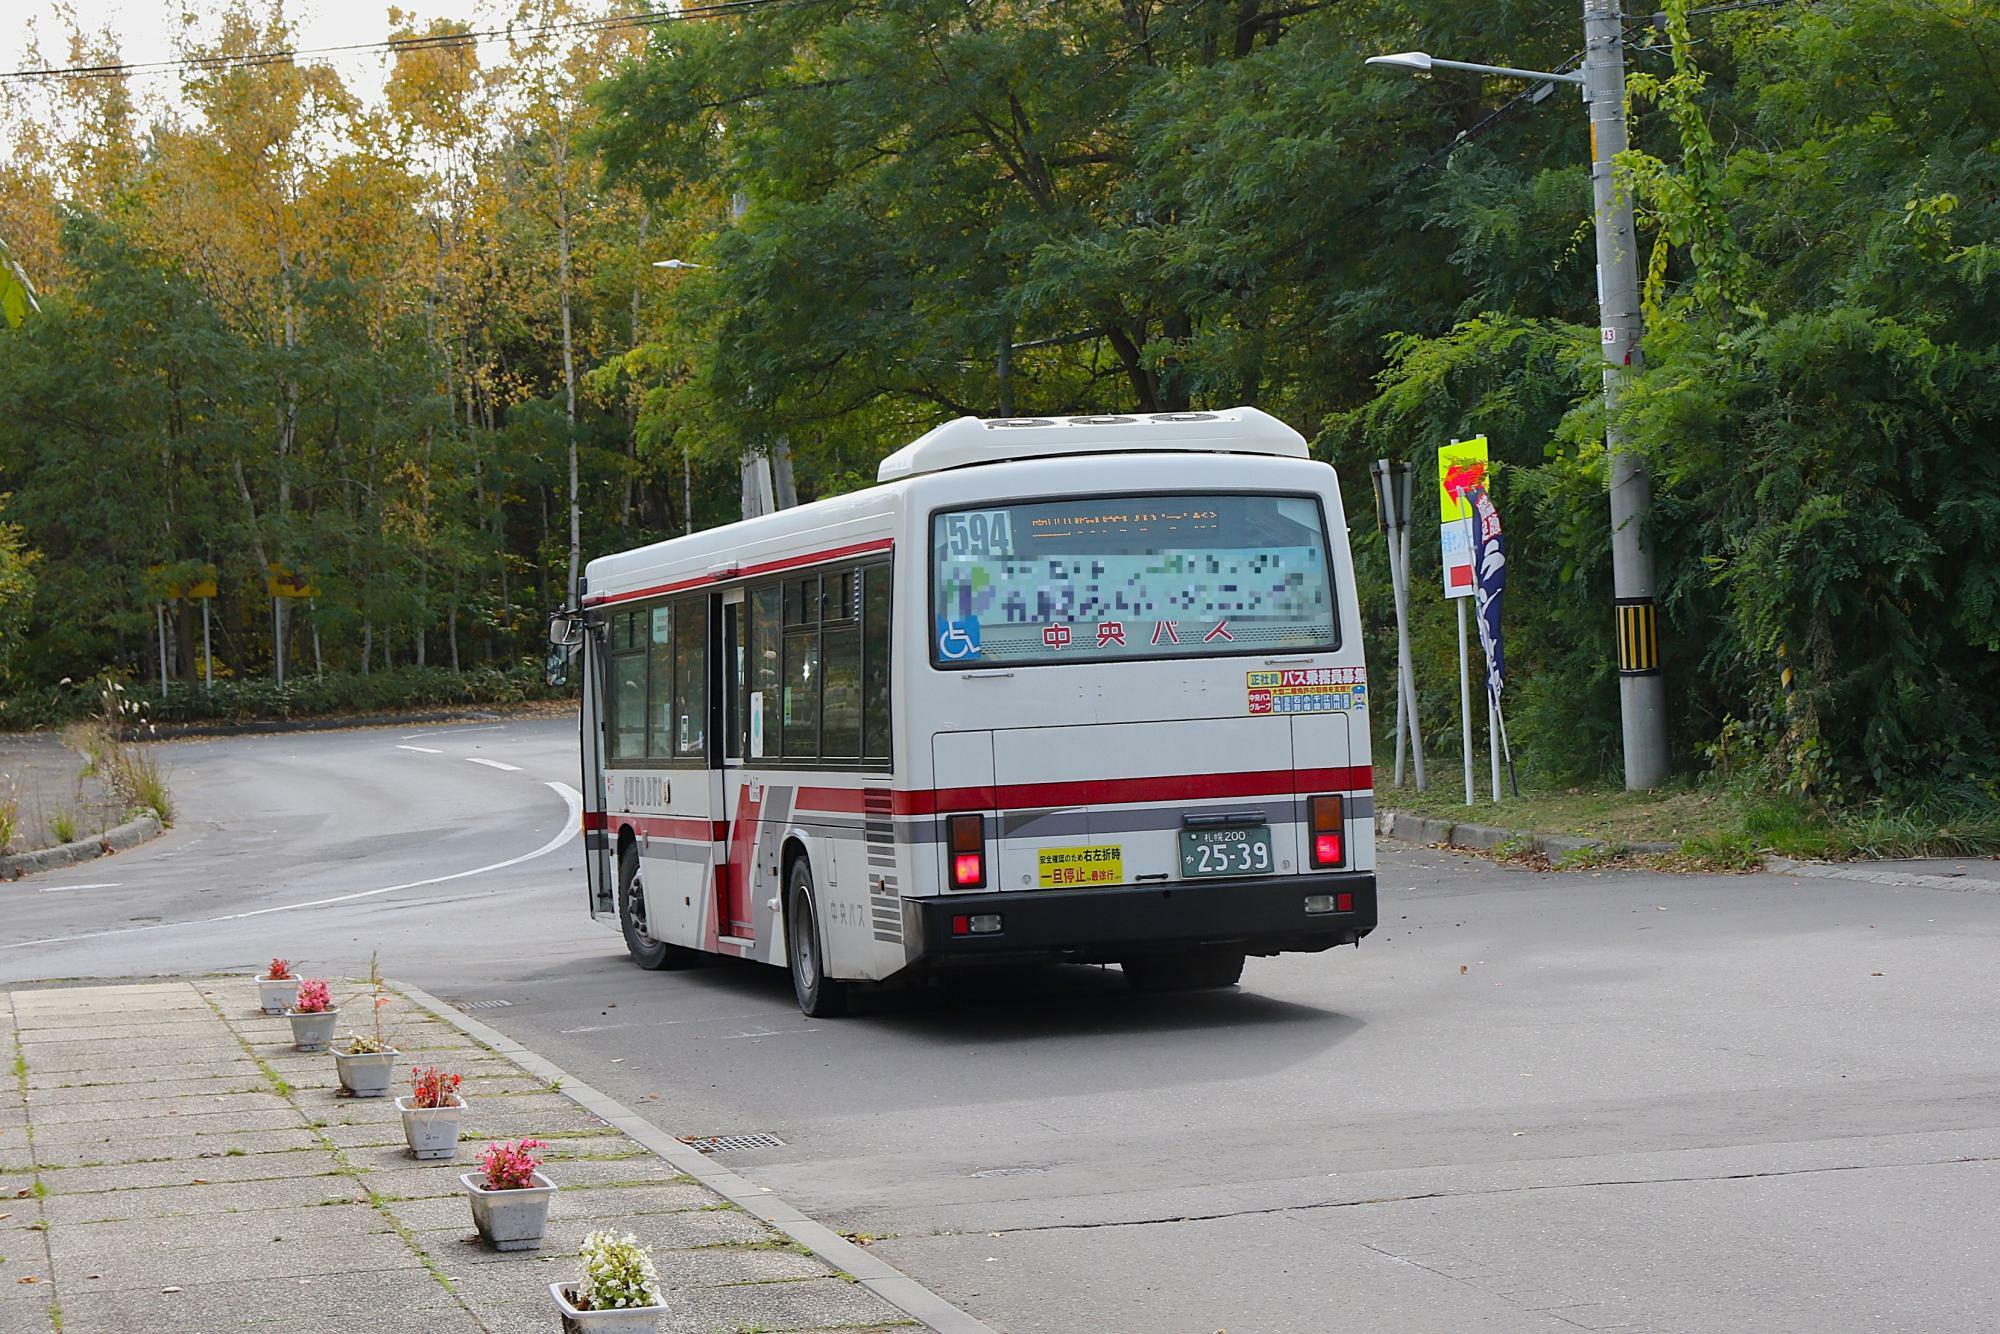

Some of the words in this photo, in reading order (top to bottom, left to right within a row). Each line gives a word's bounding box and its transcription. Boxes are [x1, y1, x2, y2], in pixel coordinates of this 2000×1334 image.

[949, 512, 1010, 555] 594
[1042, 620, 1233, 650] 中央バス
[1196, 842, 1268, 873] 25-39
